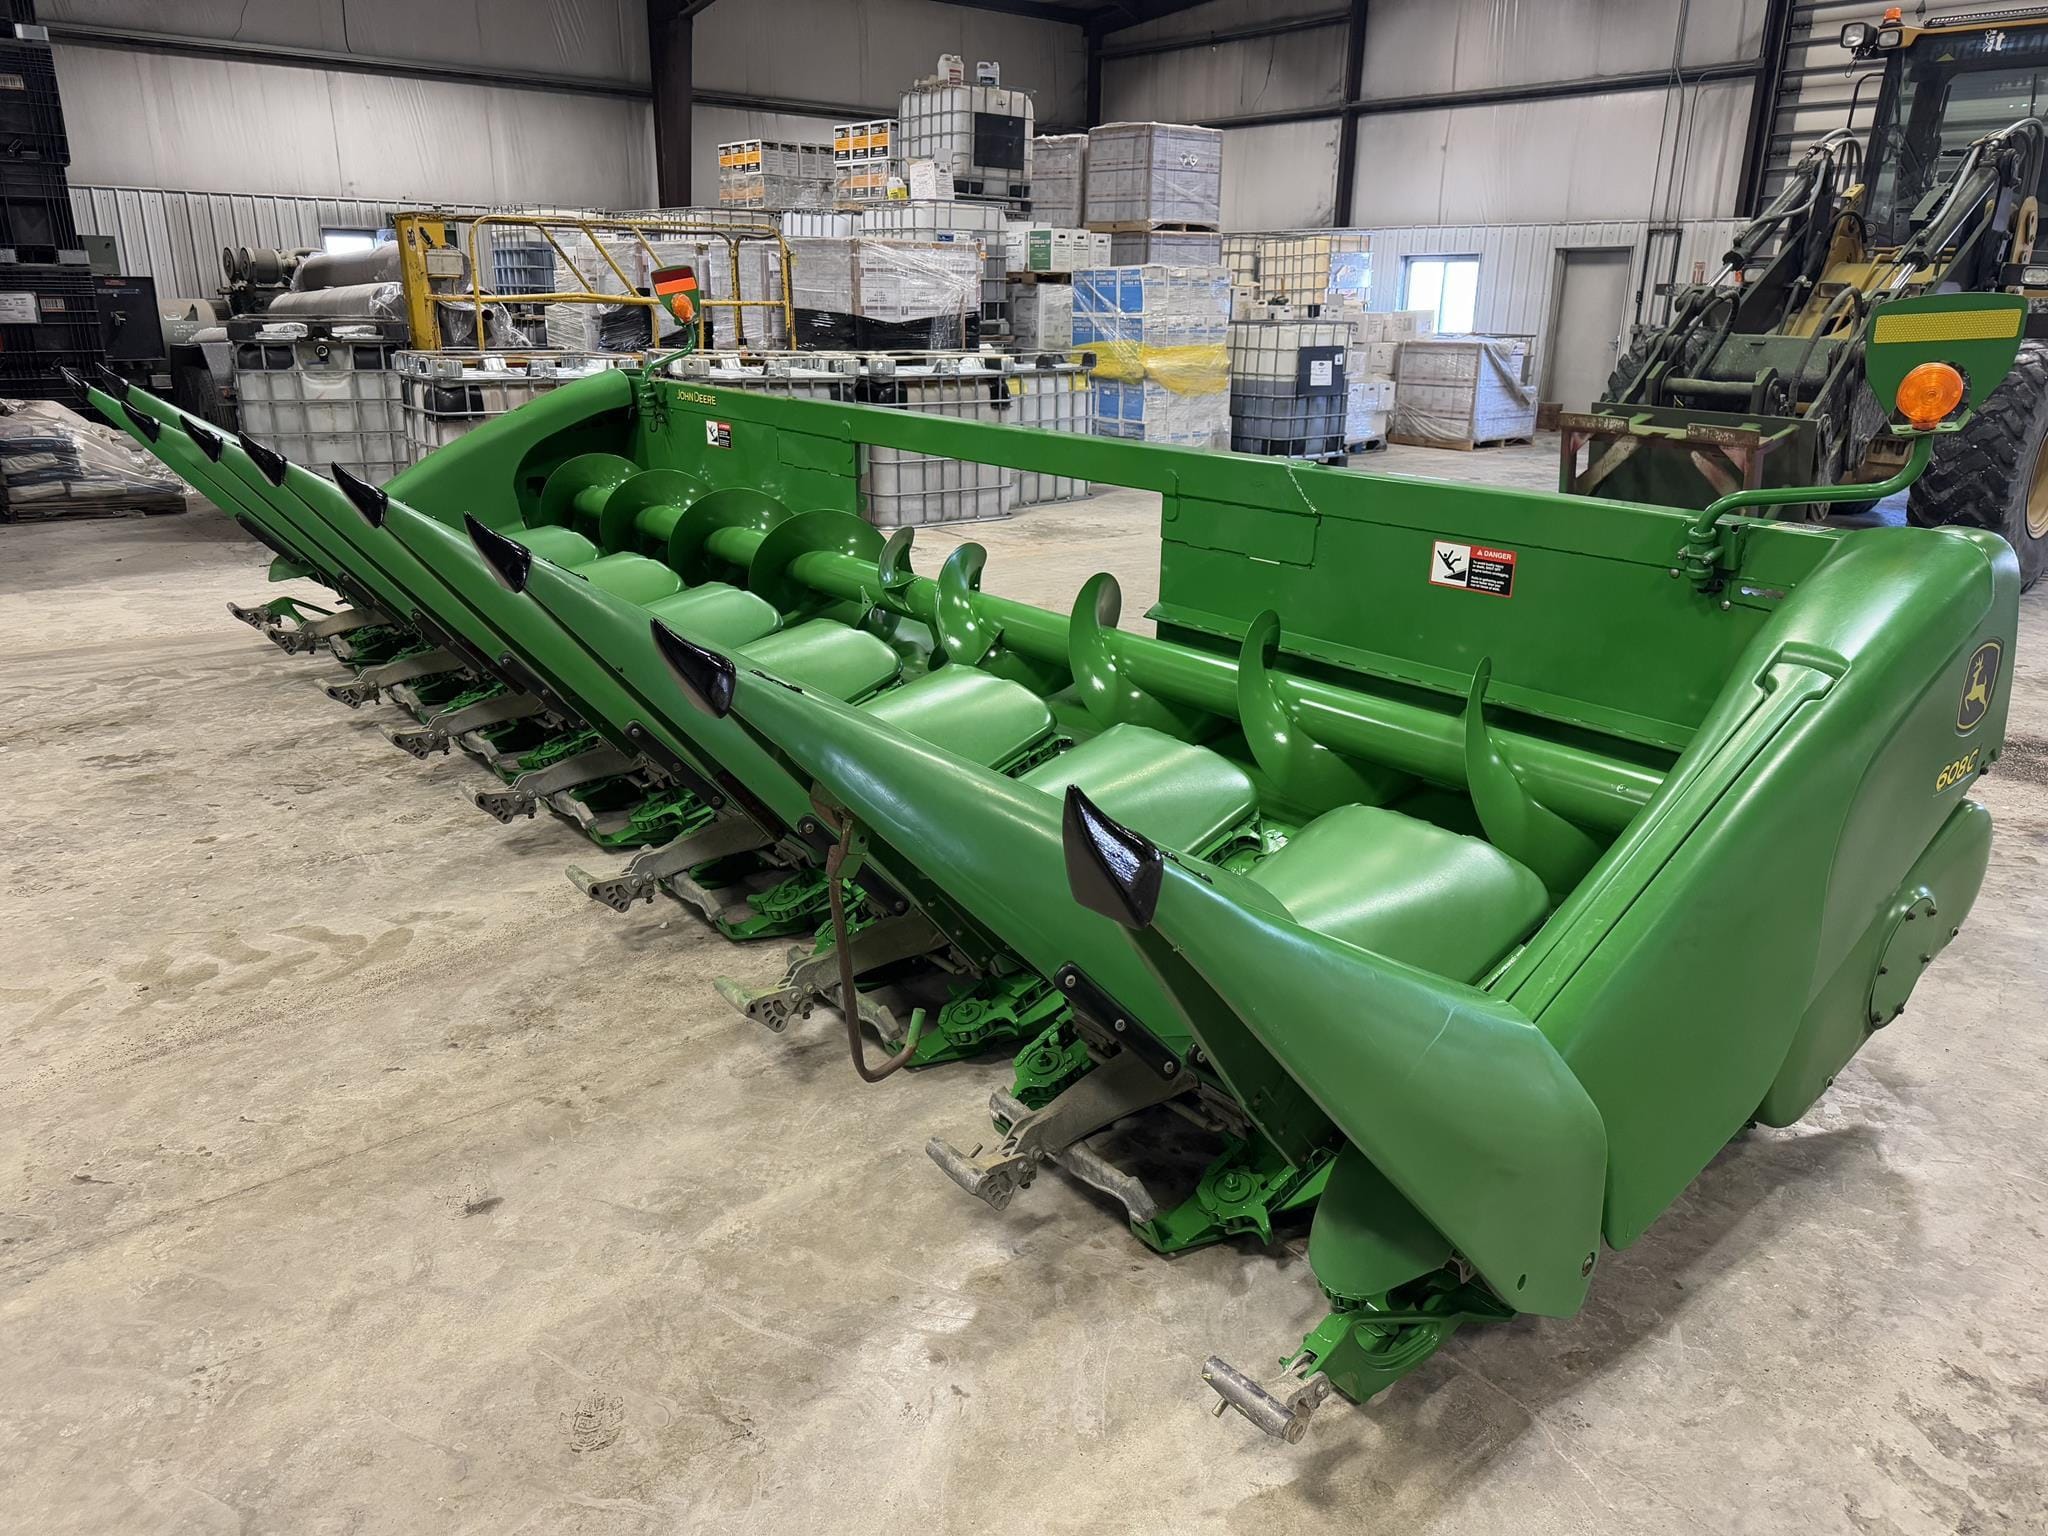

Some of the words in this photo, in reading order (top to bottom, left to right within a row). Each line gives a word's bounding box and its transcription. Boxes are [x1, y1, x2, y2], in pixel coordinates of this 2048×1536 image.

[677, 389, 694, 402] JOHN
[694, 391, 717, 405] DEERE
[1483, 550, 1512, 561] DANGER
[1936, 748, 1979, 792] 608C
